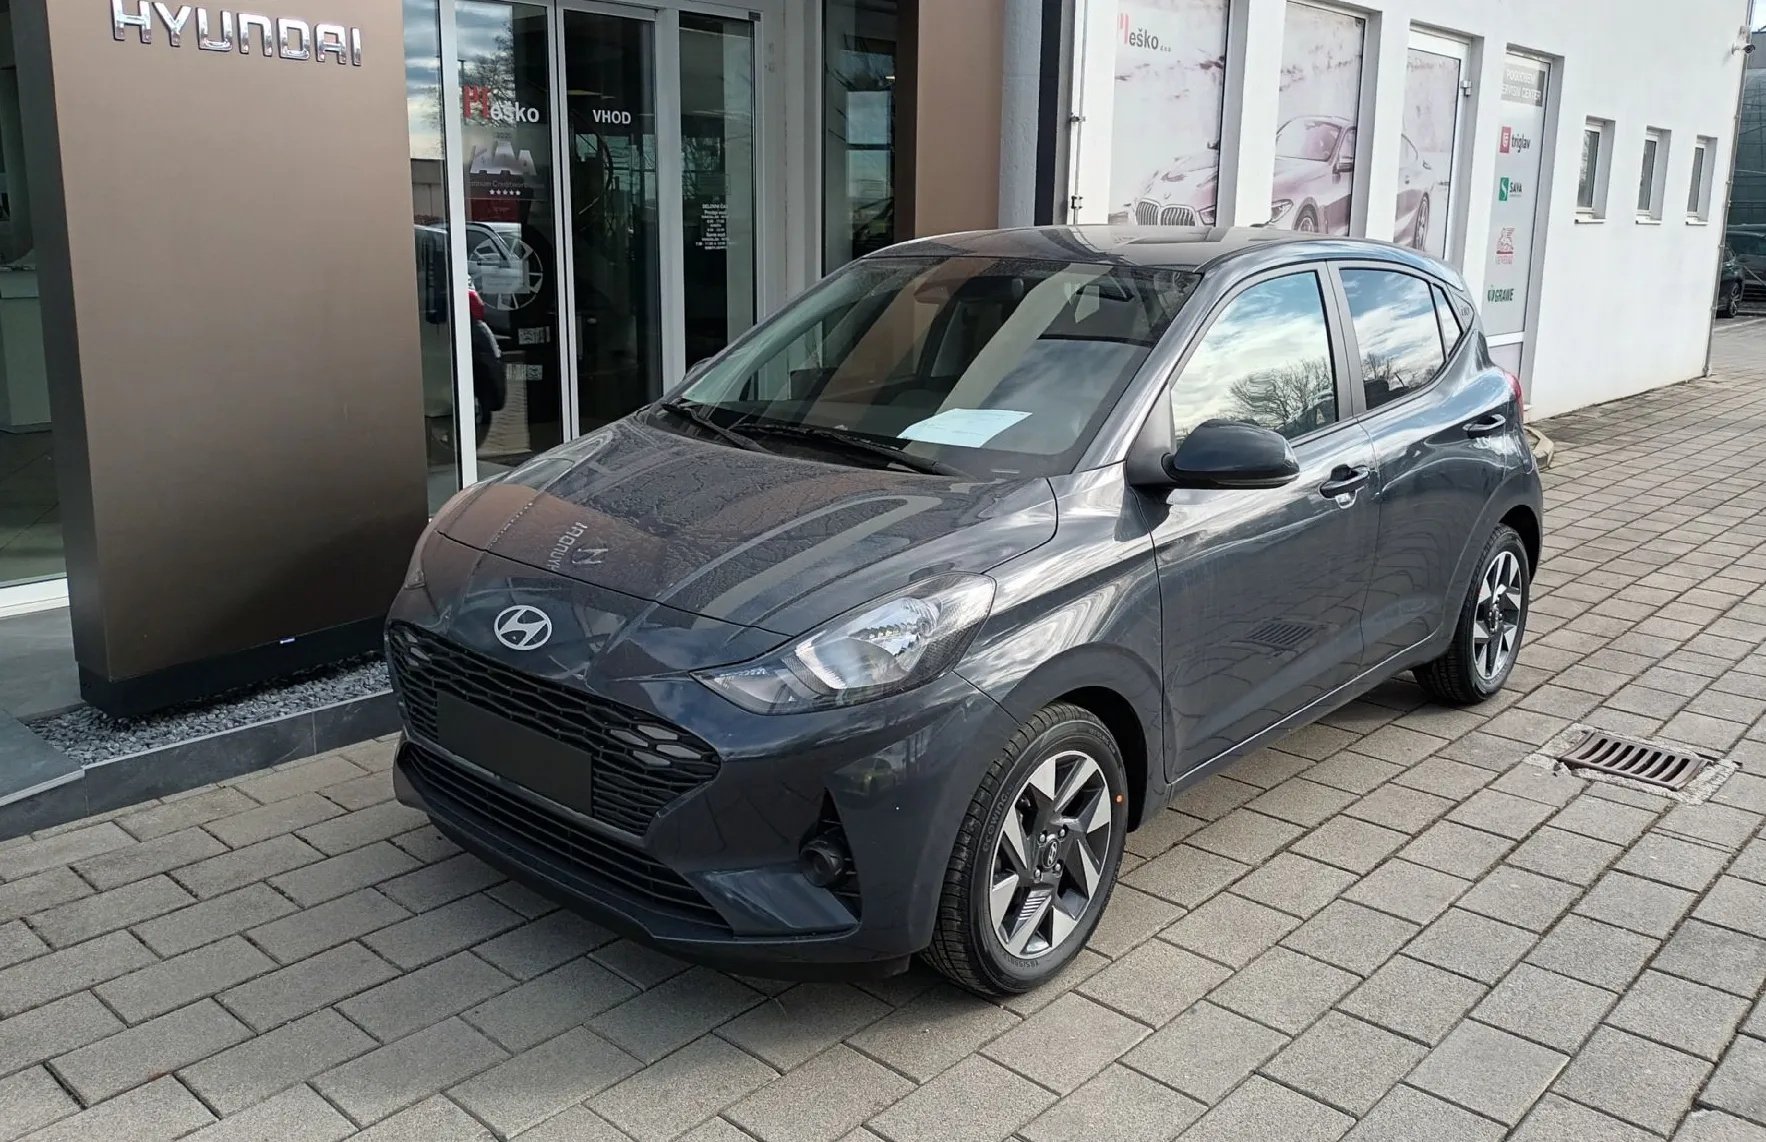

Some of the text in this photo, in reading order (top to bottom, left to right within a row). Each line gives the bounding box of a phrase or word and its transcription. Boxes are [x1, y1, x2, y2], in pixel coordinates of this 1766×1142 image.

[110, 0, 362, 66] HYUNDAI
[592, 109, 632, 125] VHOD
[1511, 133, 1531, 153] triglav
[1509, 182, 1522, 193] SAVA
[1494, 288, 1514, 302] GRAWE
